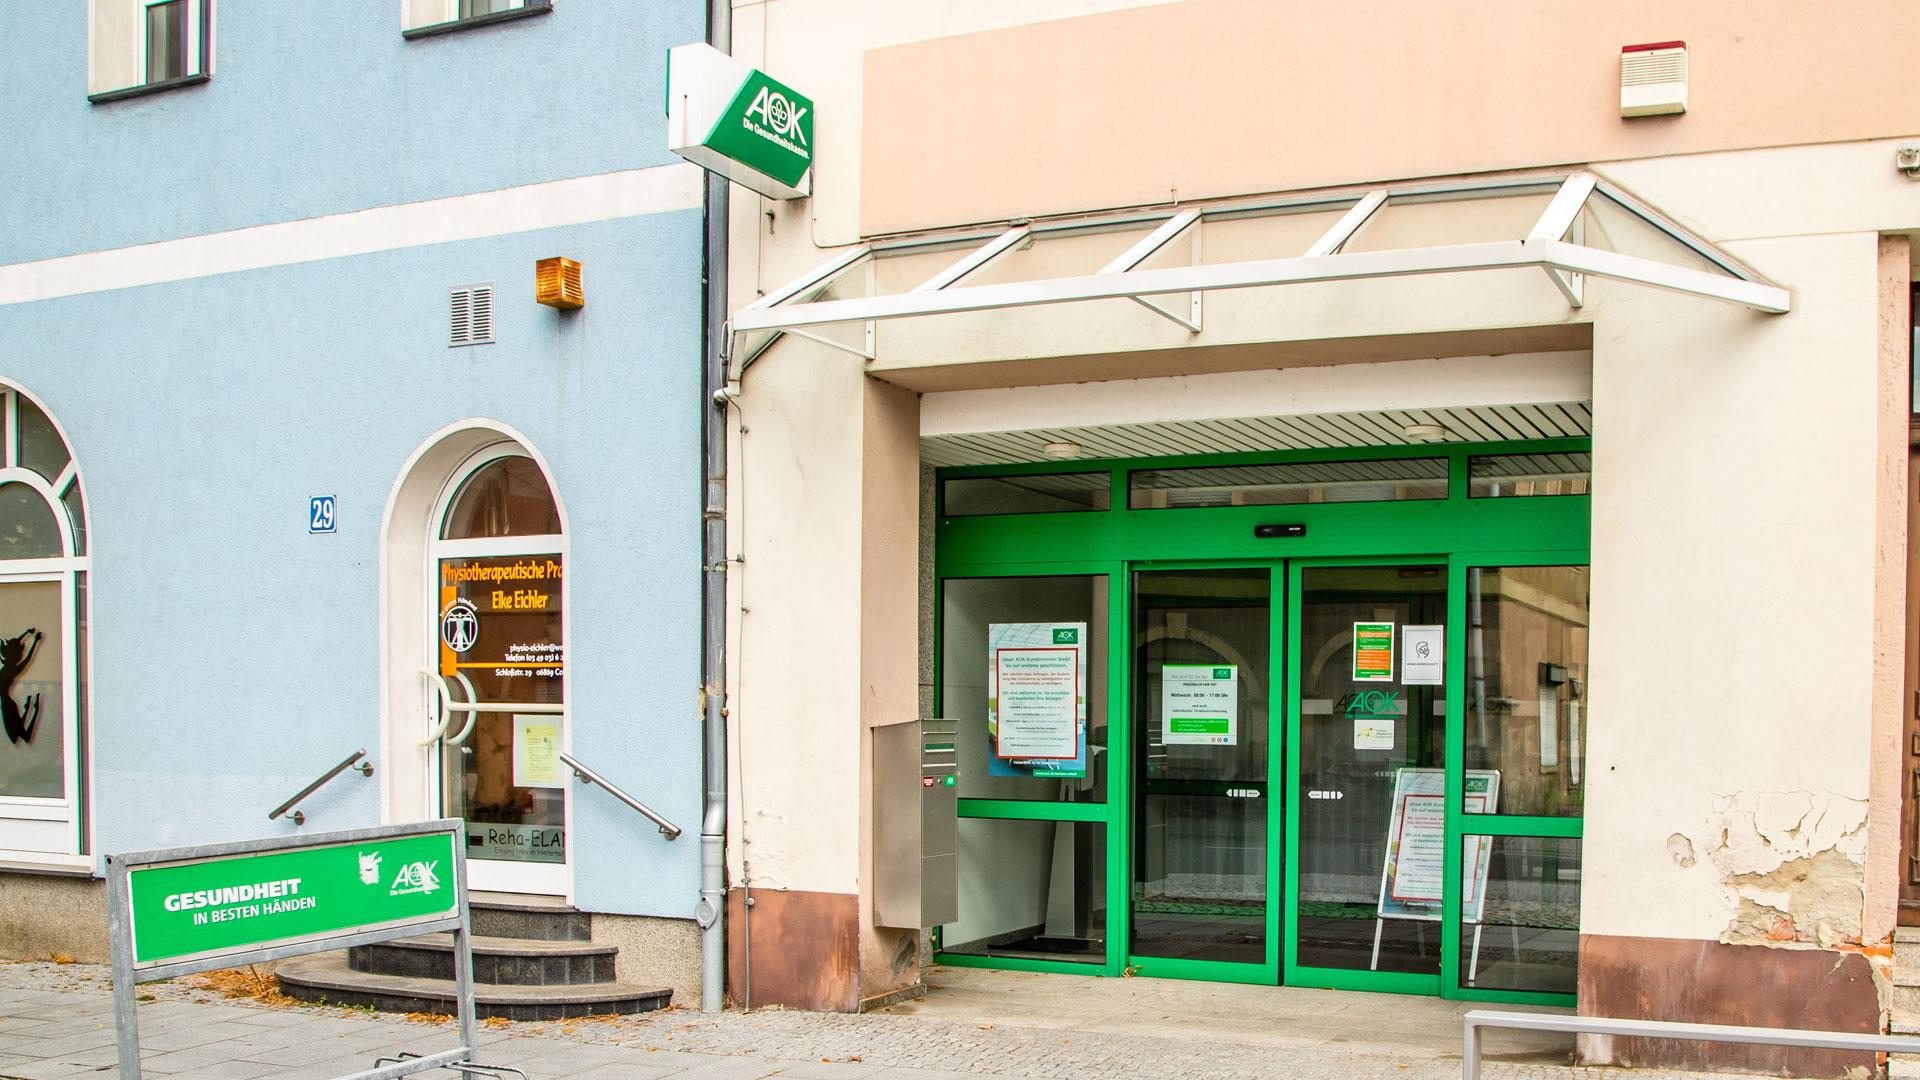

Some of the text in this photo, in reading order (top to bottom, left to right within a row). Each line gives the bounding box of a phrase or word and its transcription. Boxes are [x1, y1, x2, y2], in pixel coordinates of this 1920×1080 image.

[743, 117, 754, 132] Die
[745, 85, 807, 147] AOK
[311, 499, 334, 529] 29
[442, 560, 544, 584] Physiotherapeutische
[491, 590, 549, 609] Elke Eichler
[1057, 630, 1074, 640] AOK
[505, 653, 526, 662] Telefon
[495, 668, 524, 677] Schloßstr.
[1345, 690, 1400, 713] AOK
[391, 859, 440, 889] AOK
[163, 877, 302, 912] GESUNDHEIT
[193, 895, 317, 926] IN BESTEN HÄNDEN
